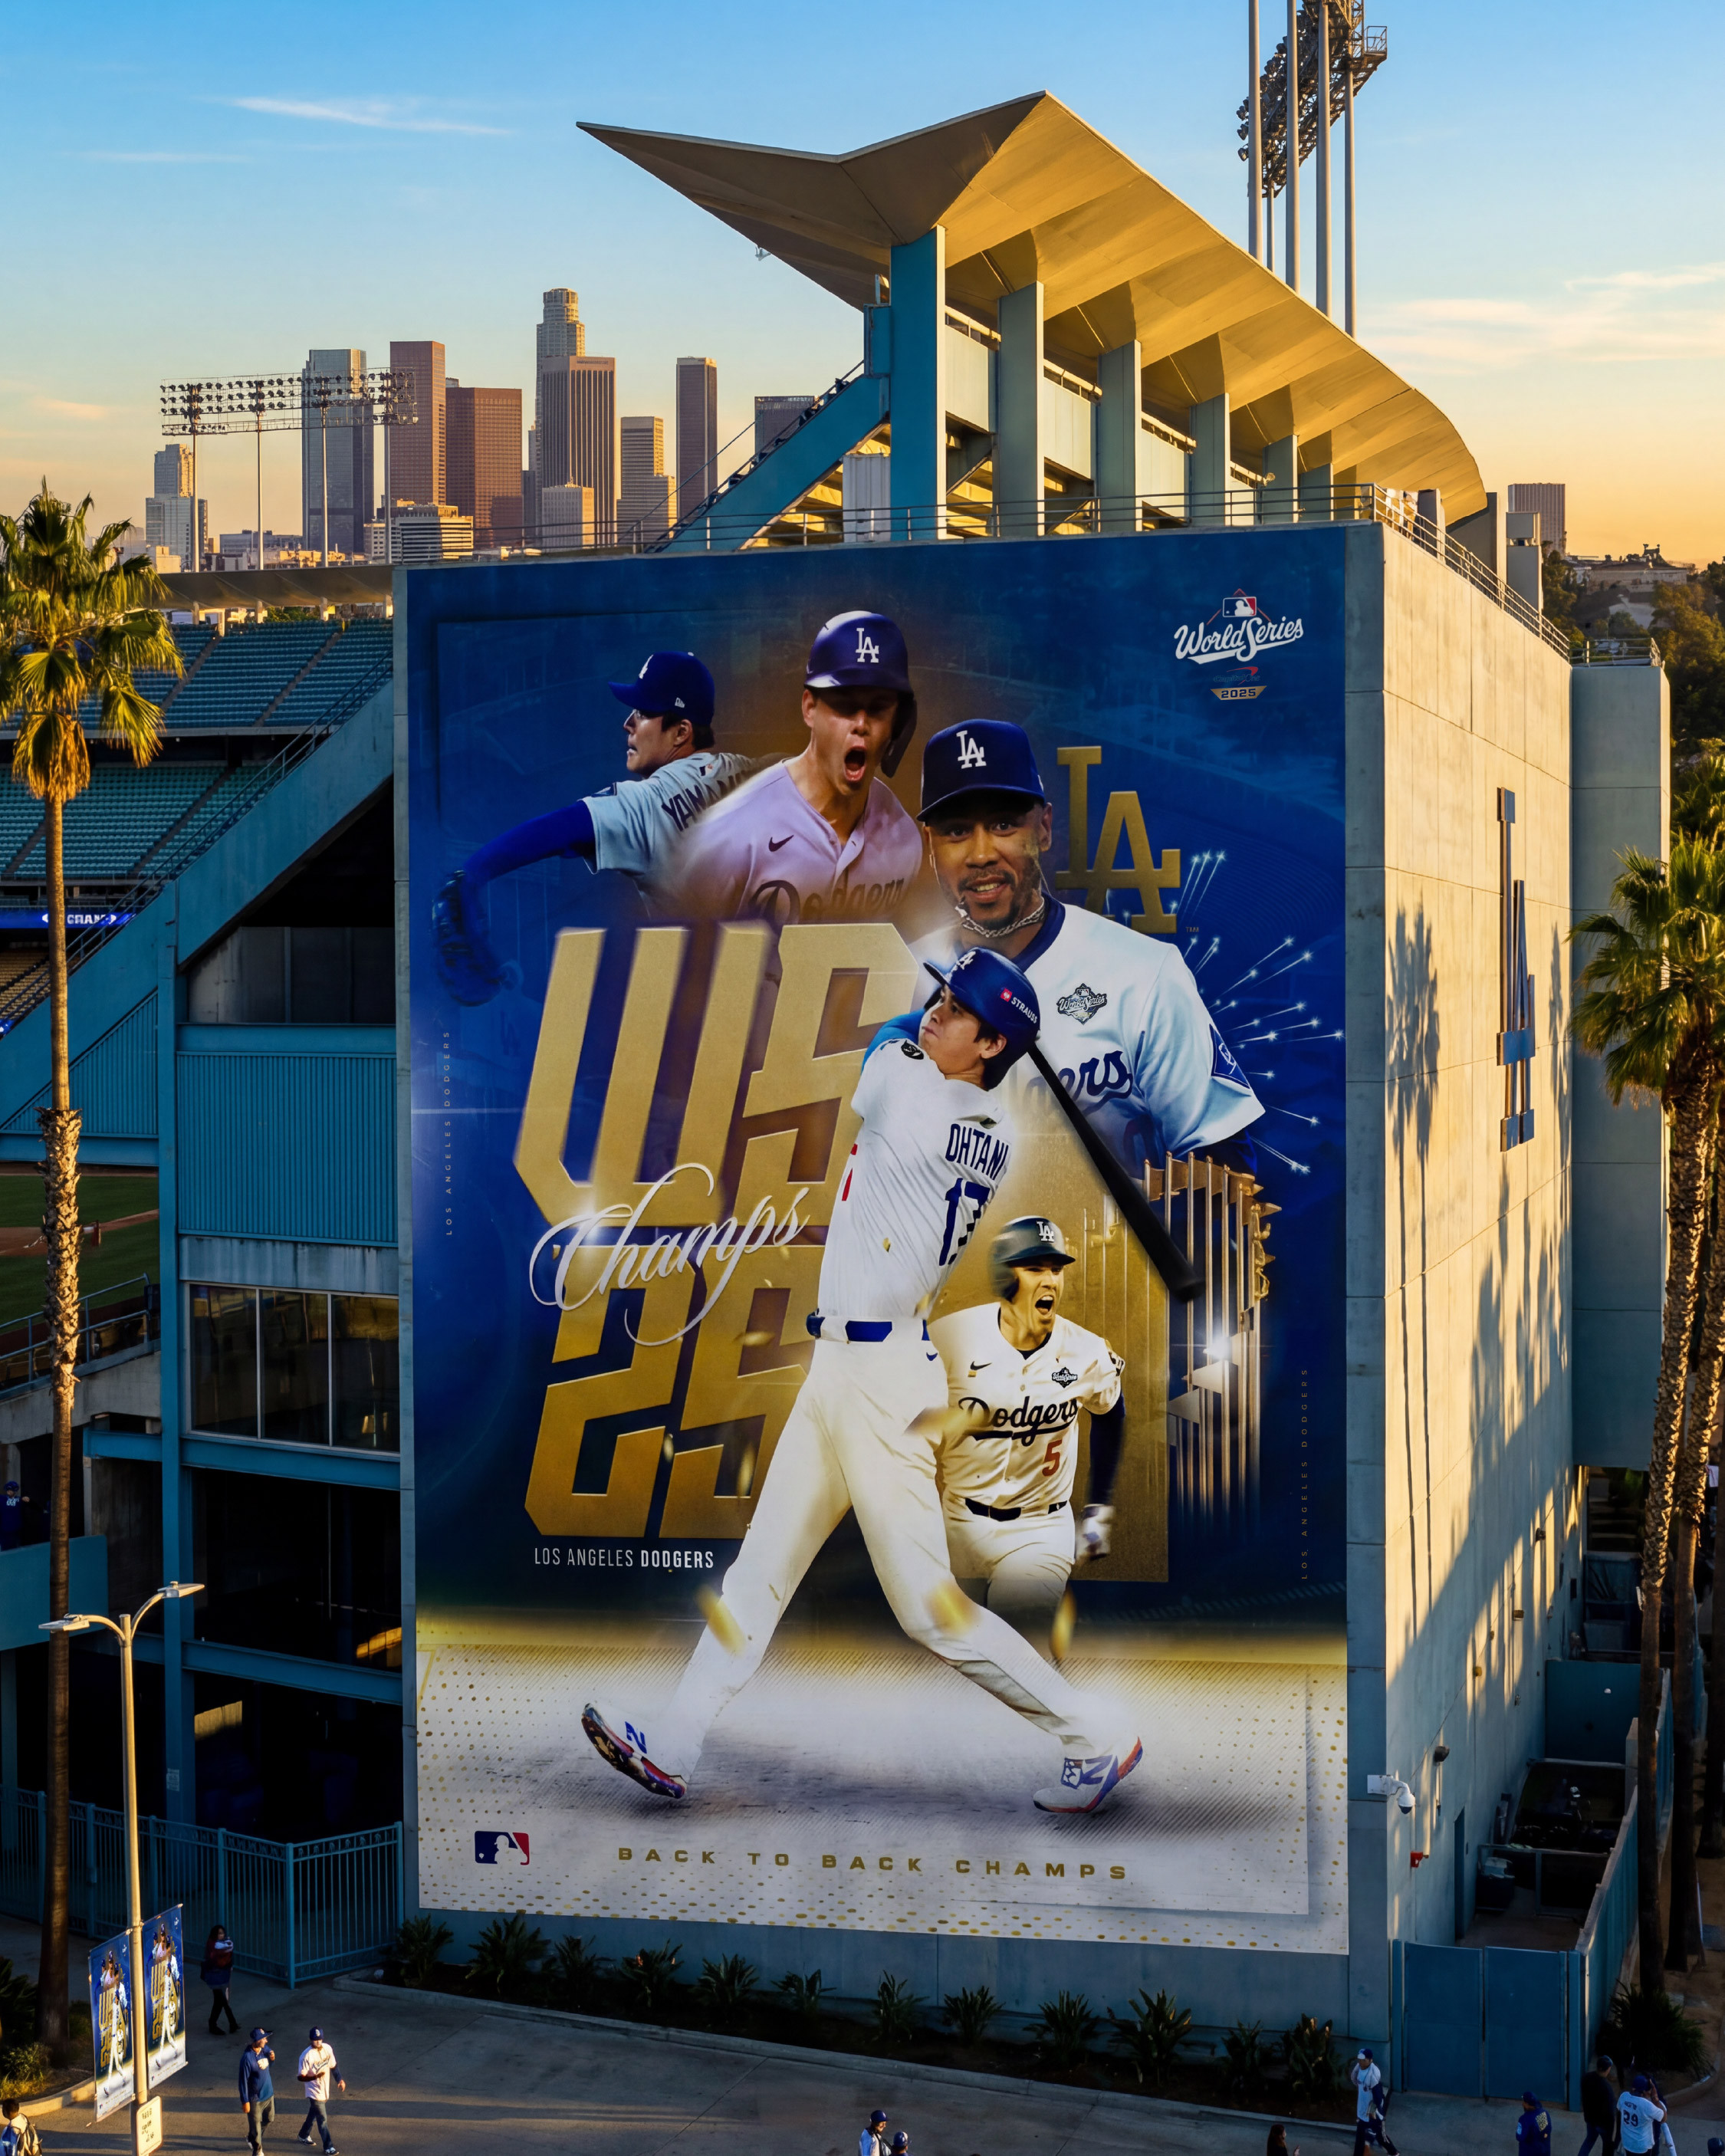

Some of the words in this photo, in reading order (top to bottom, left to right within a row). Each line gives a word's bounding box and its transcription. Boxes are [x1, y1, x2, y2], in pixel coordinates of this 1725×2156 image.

[856, 627, 879, 663] LA
[1174, 620, 1247, 659] World
[1236, 616, 1304, 662] Series
[1221, 689, 1256, 698] 2025
[956, 730, 987, 769] LA
[1055, 746, 1181, 934] LA
[1011, 997, 1038, 1024] STRAUSS
[945, 1123, 1009, 1181] OHTANI
[939, 1178, 991, 1266] 17
[1037, 1221, 1055, 1242] LA
[529, 1163, 810, 1347] Champs
[1042, 1439, 1063, 1477] 5
[534, 1547, 560, 1565] LOS
[567, 1548, 633, 1567] ANGELES
[641, 1550, 714, 1569] DODGERS
[618, 1848, 715, 1865] BACK
[747, 1852, 790, 1866] TO
[822, 1854, 922, 1872] BACK
[955, 1859, 1125, 1880] CHAMPS
